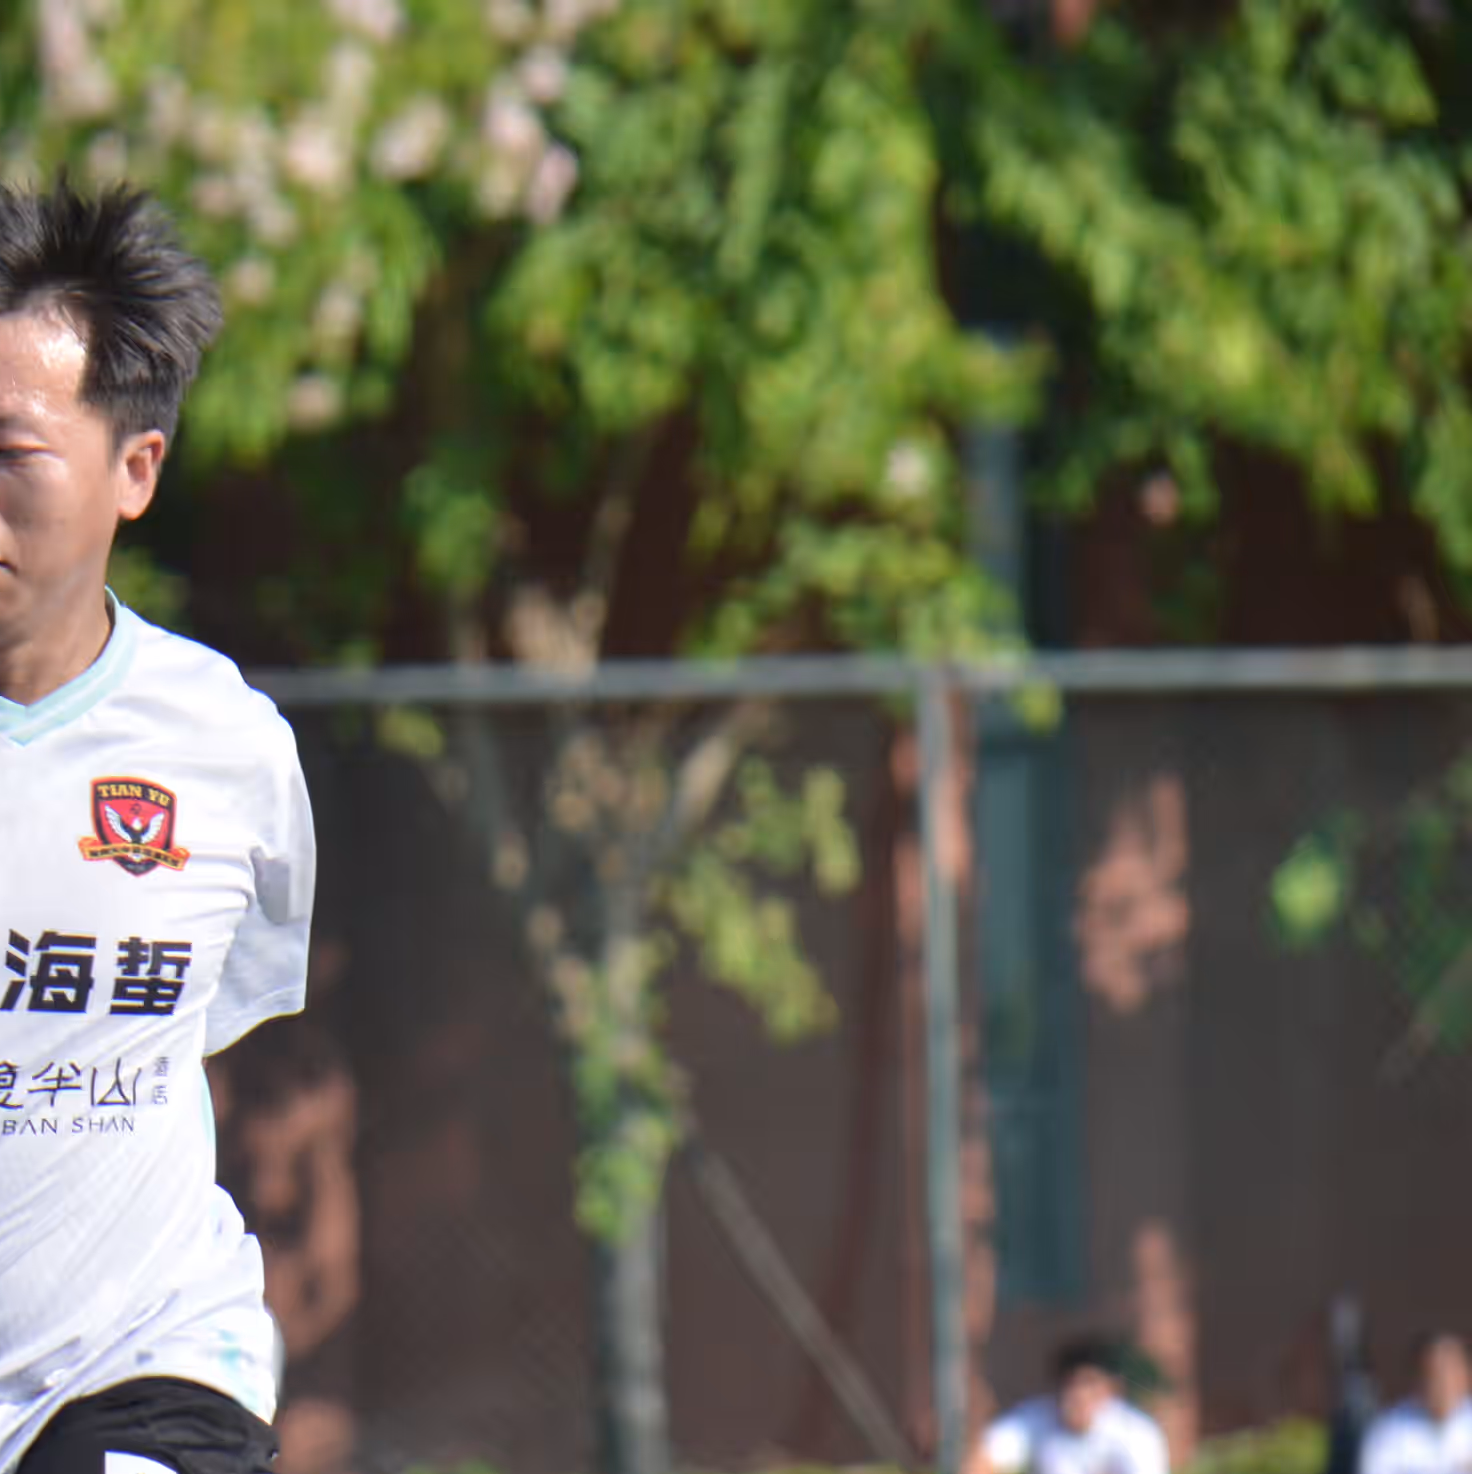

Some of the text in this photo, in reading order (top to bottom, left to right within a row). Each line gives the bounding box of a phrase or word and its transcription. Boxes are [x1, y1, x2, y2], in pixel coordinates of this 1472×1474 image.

[96, 783, 143, 799] TIAN
[1, 1117, 58, 1137] BAN
[71, 1115, 135, 1135] SHAN
